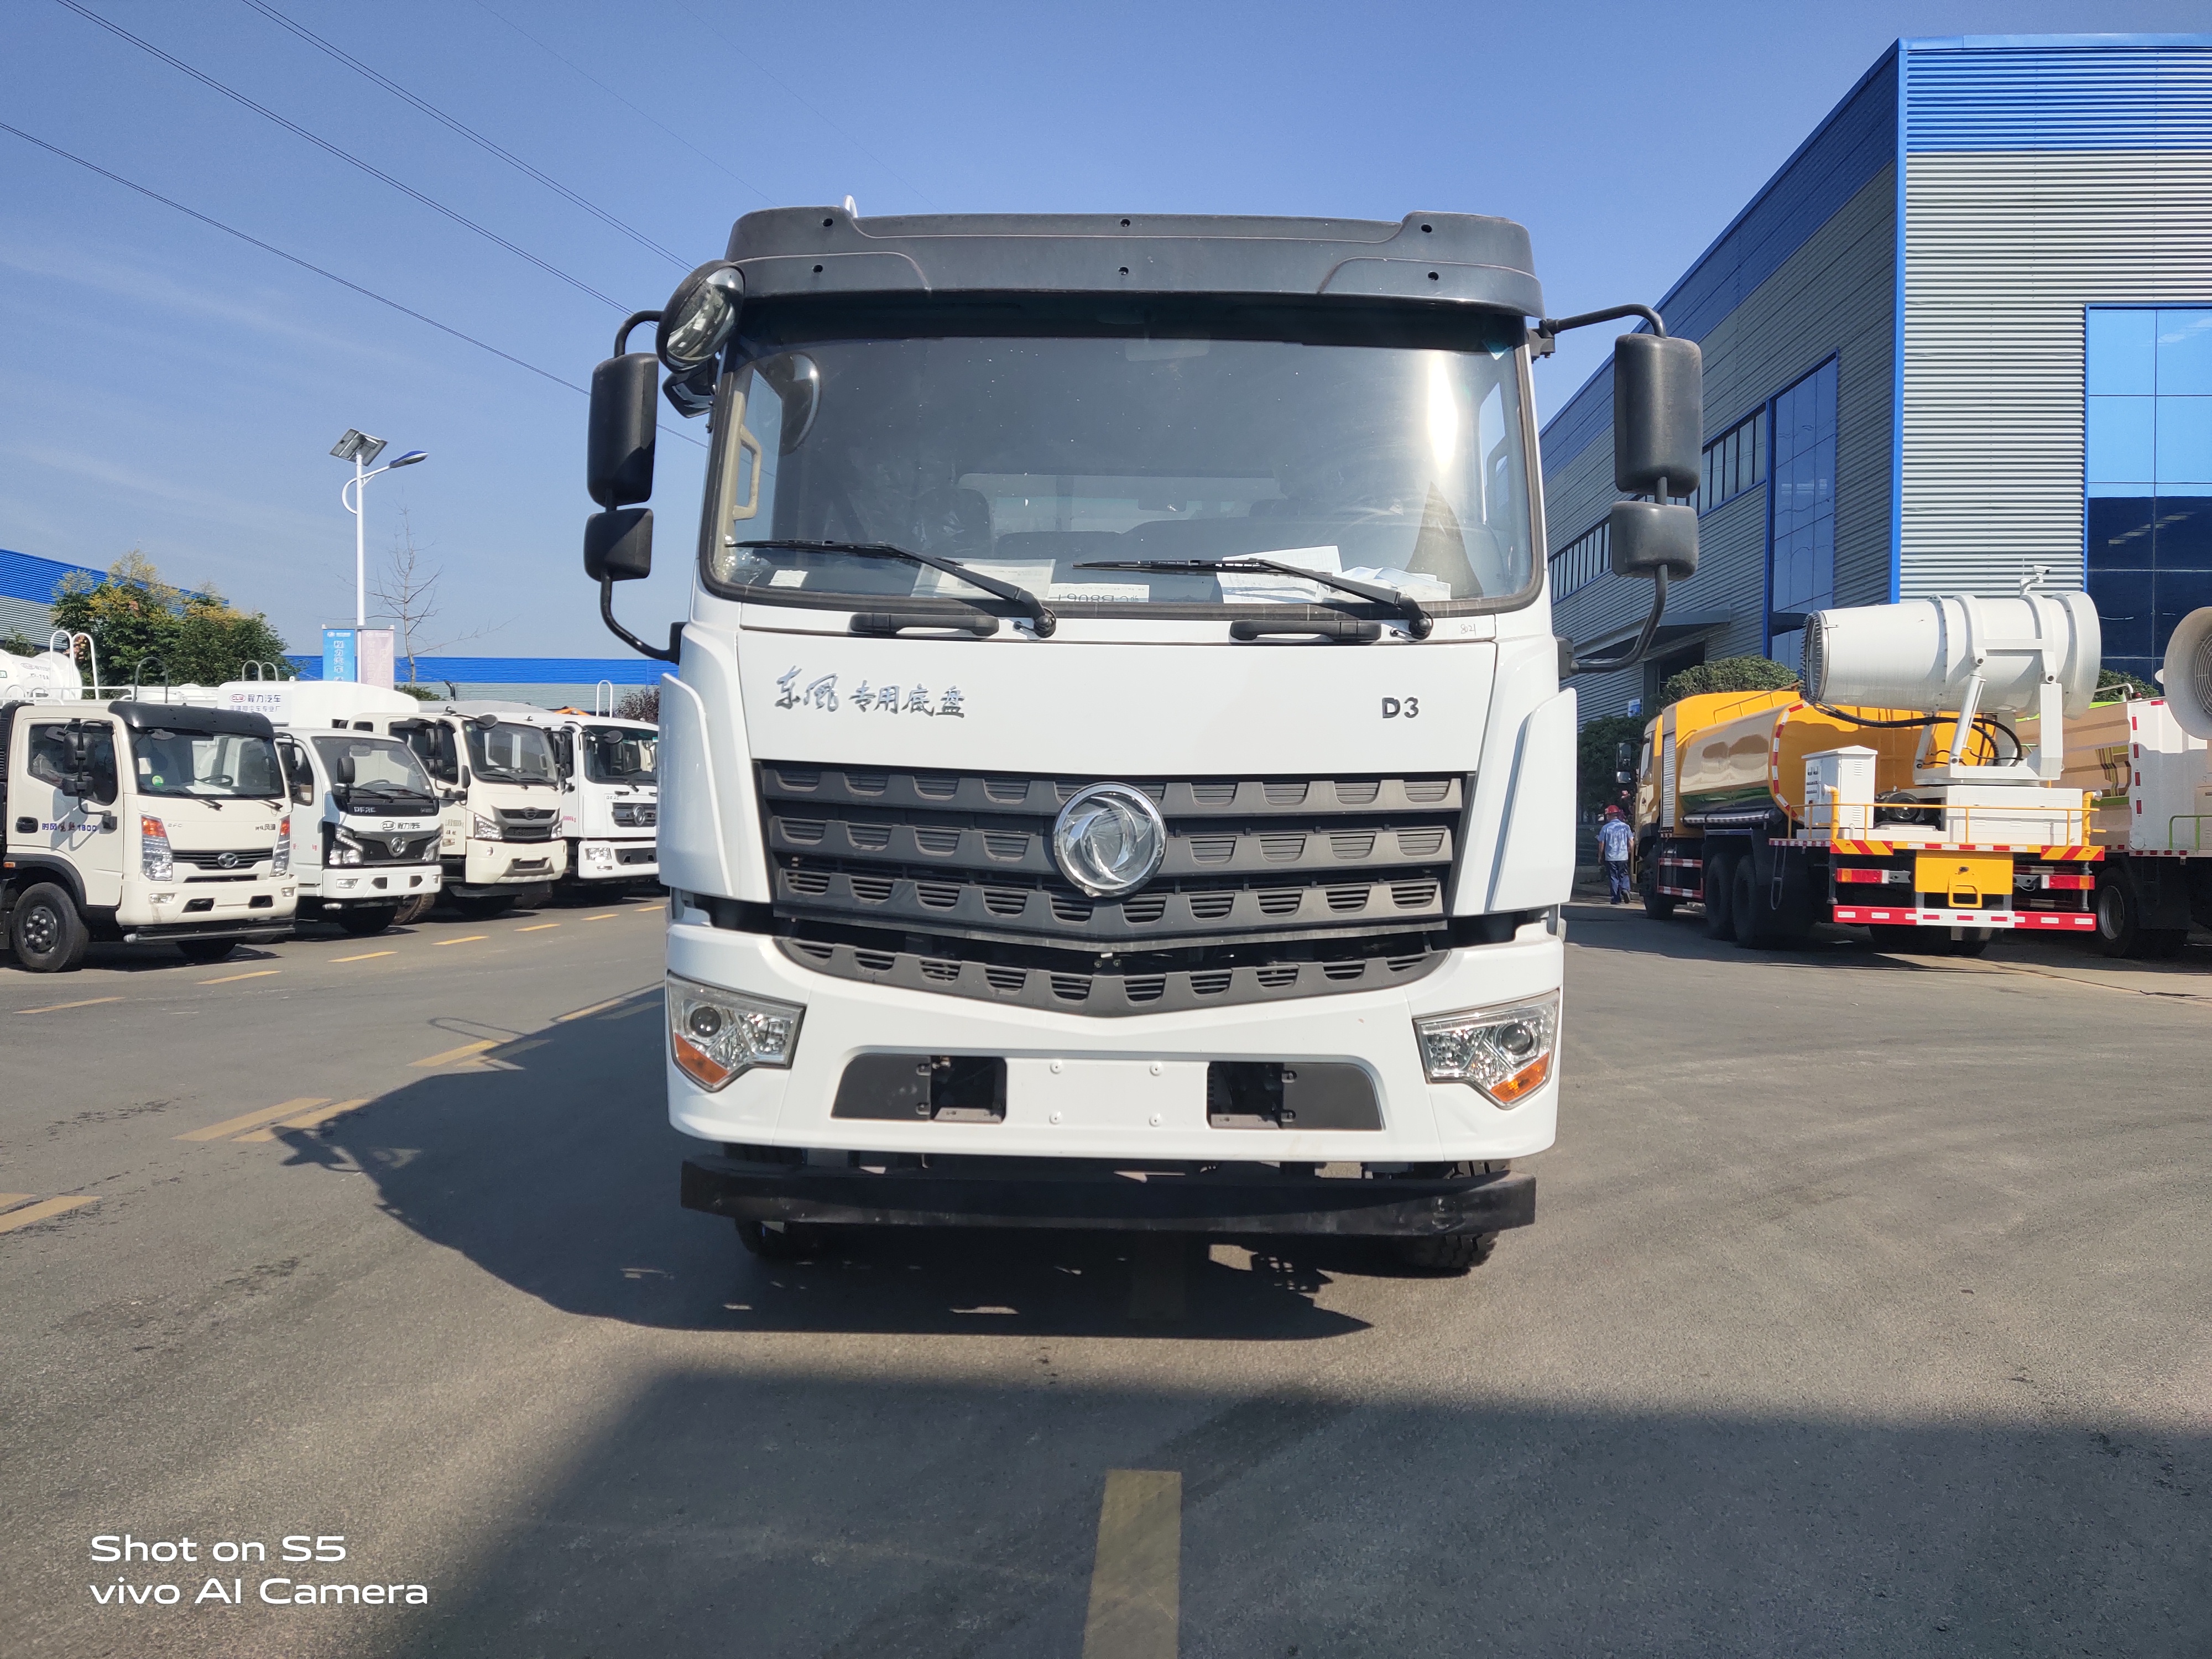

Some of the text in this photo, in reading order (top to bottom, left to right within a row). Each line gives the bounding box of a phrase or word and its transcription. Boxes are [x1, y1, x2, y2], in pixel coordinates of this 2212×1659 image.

[248, 694, 281, 702] 程力汽车
[848, 680, 964, 718] 专用底盘
[1382, 697, 1419, 718] D3
